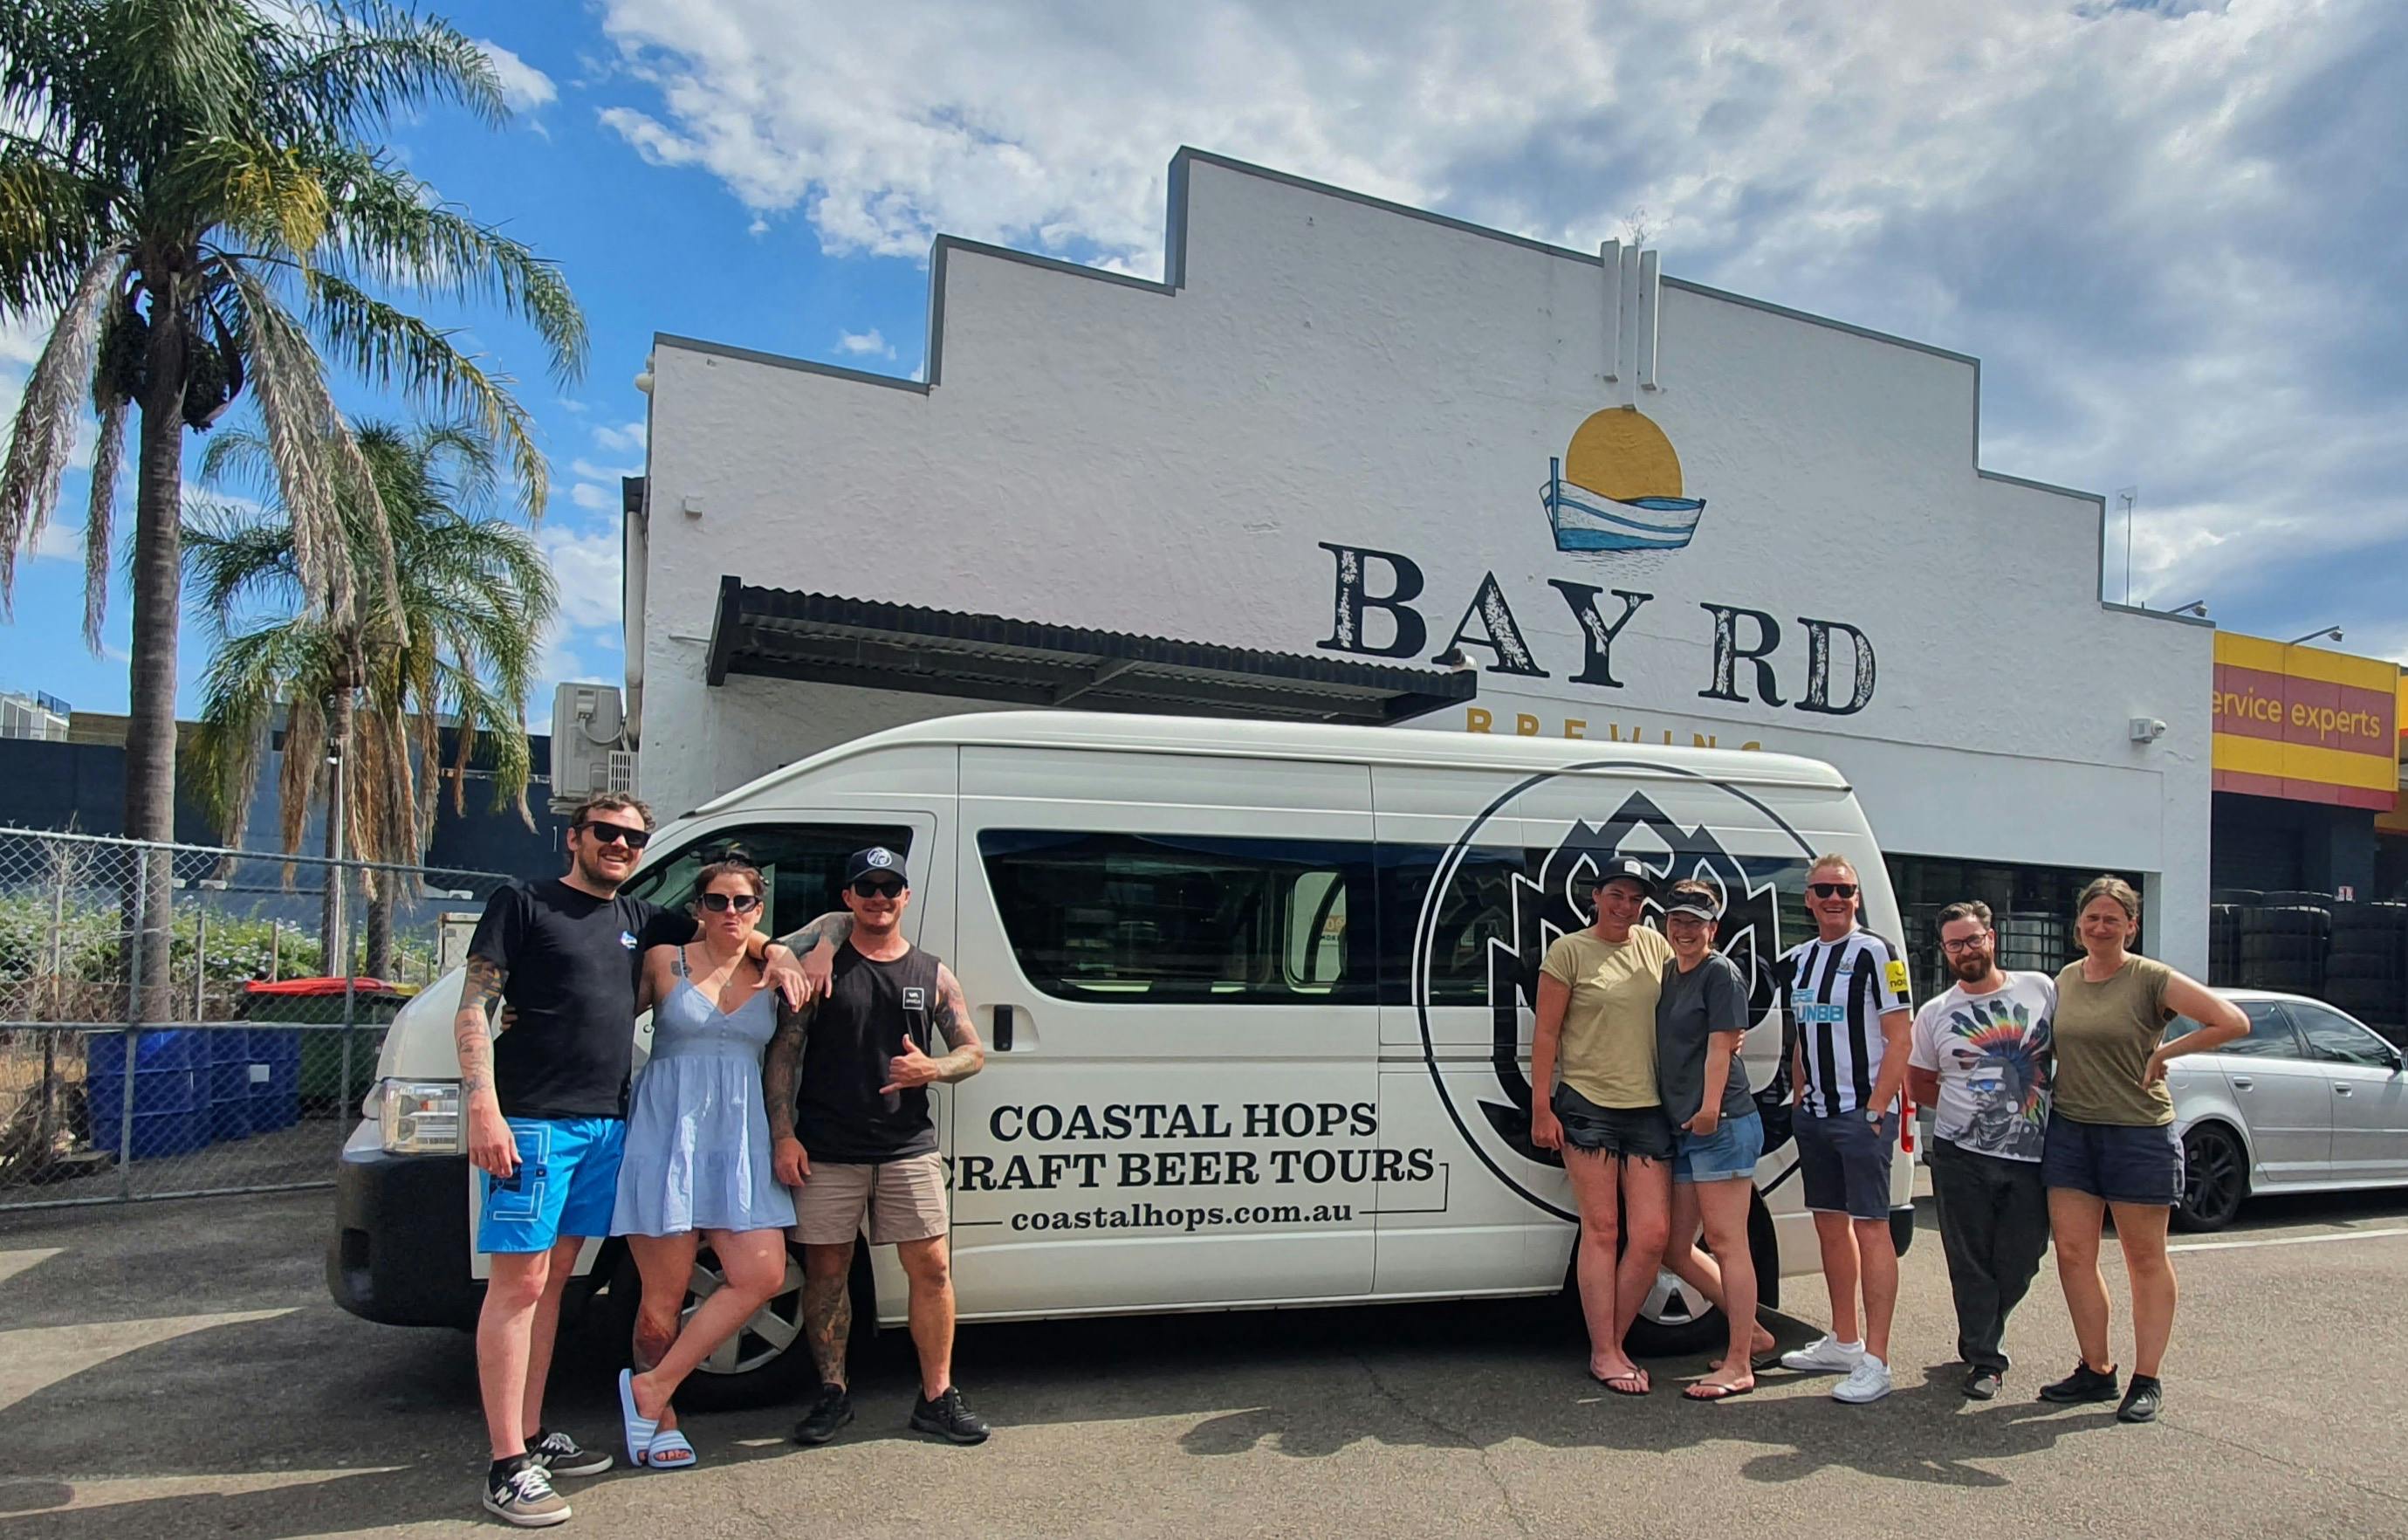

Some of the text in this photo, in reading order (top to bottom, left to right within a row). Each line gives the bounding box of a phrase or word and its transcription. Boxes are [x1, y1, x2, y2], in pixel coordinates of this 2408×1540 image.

[1316, 541, 1877, 716] BAY RD
[1467, 707, 1760, 751] BREW
[2212, 686, 2381, 741] ervice experts
[989, 1102, 1377, 1142] COASTAL HOPS
[1117, 1151, 1260, 1187] BEER
[1270, 1147, 1435, 1184] TOURS
[1012, 1203, 1352, 1233] coastalhops.com.au
